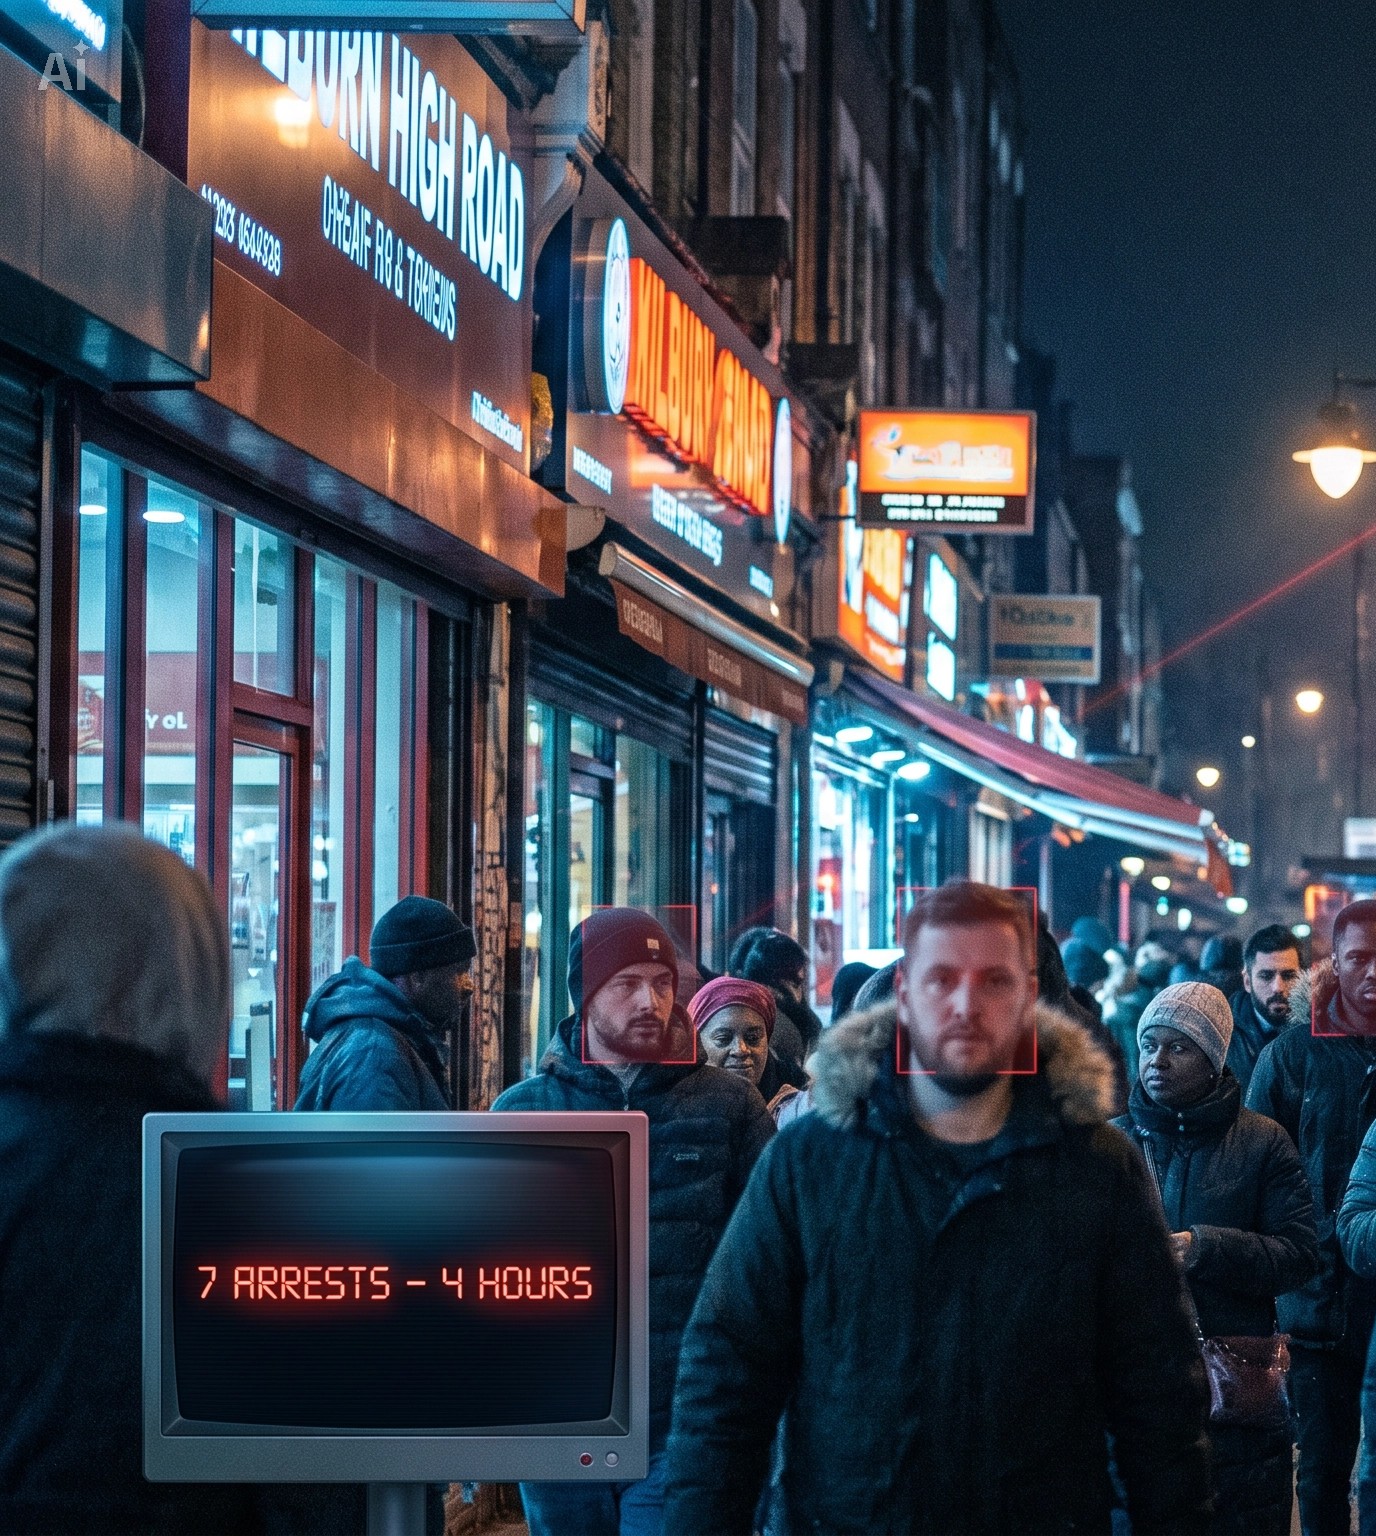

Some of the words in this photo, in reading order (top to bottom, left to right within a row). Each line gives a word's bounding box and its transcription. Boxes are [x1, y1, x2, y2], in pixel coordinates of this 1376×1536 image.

[388, 33, 456, 241] HIGH
[461, 112, 525, 301] ROAD
[197, 1265, 217, 1300] 7
[233, 1265, 391, 1300] ARRESTS
[441, 1266, 463, 1300] 4
[478, 1265, 593, 1300] HOURS
